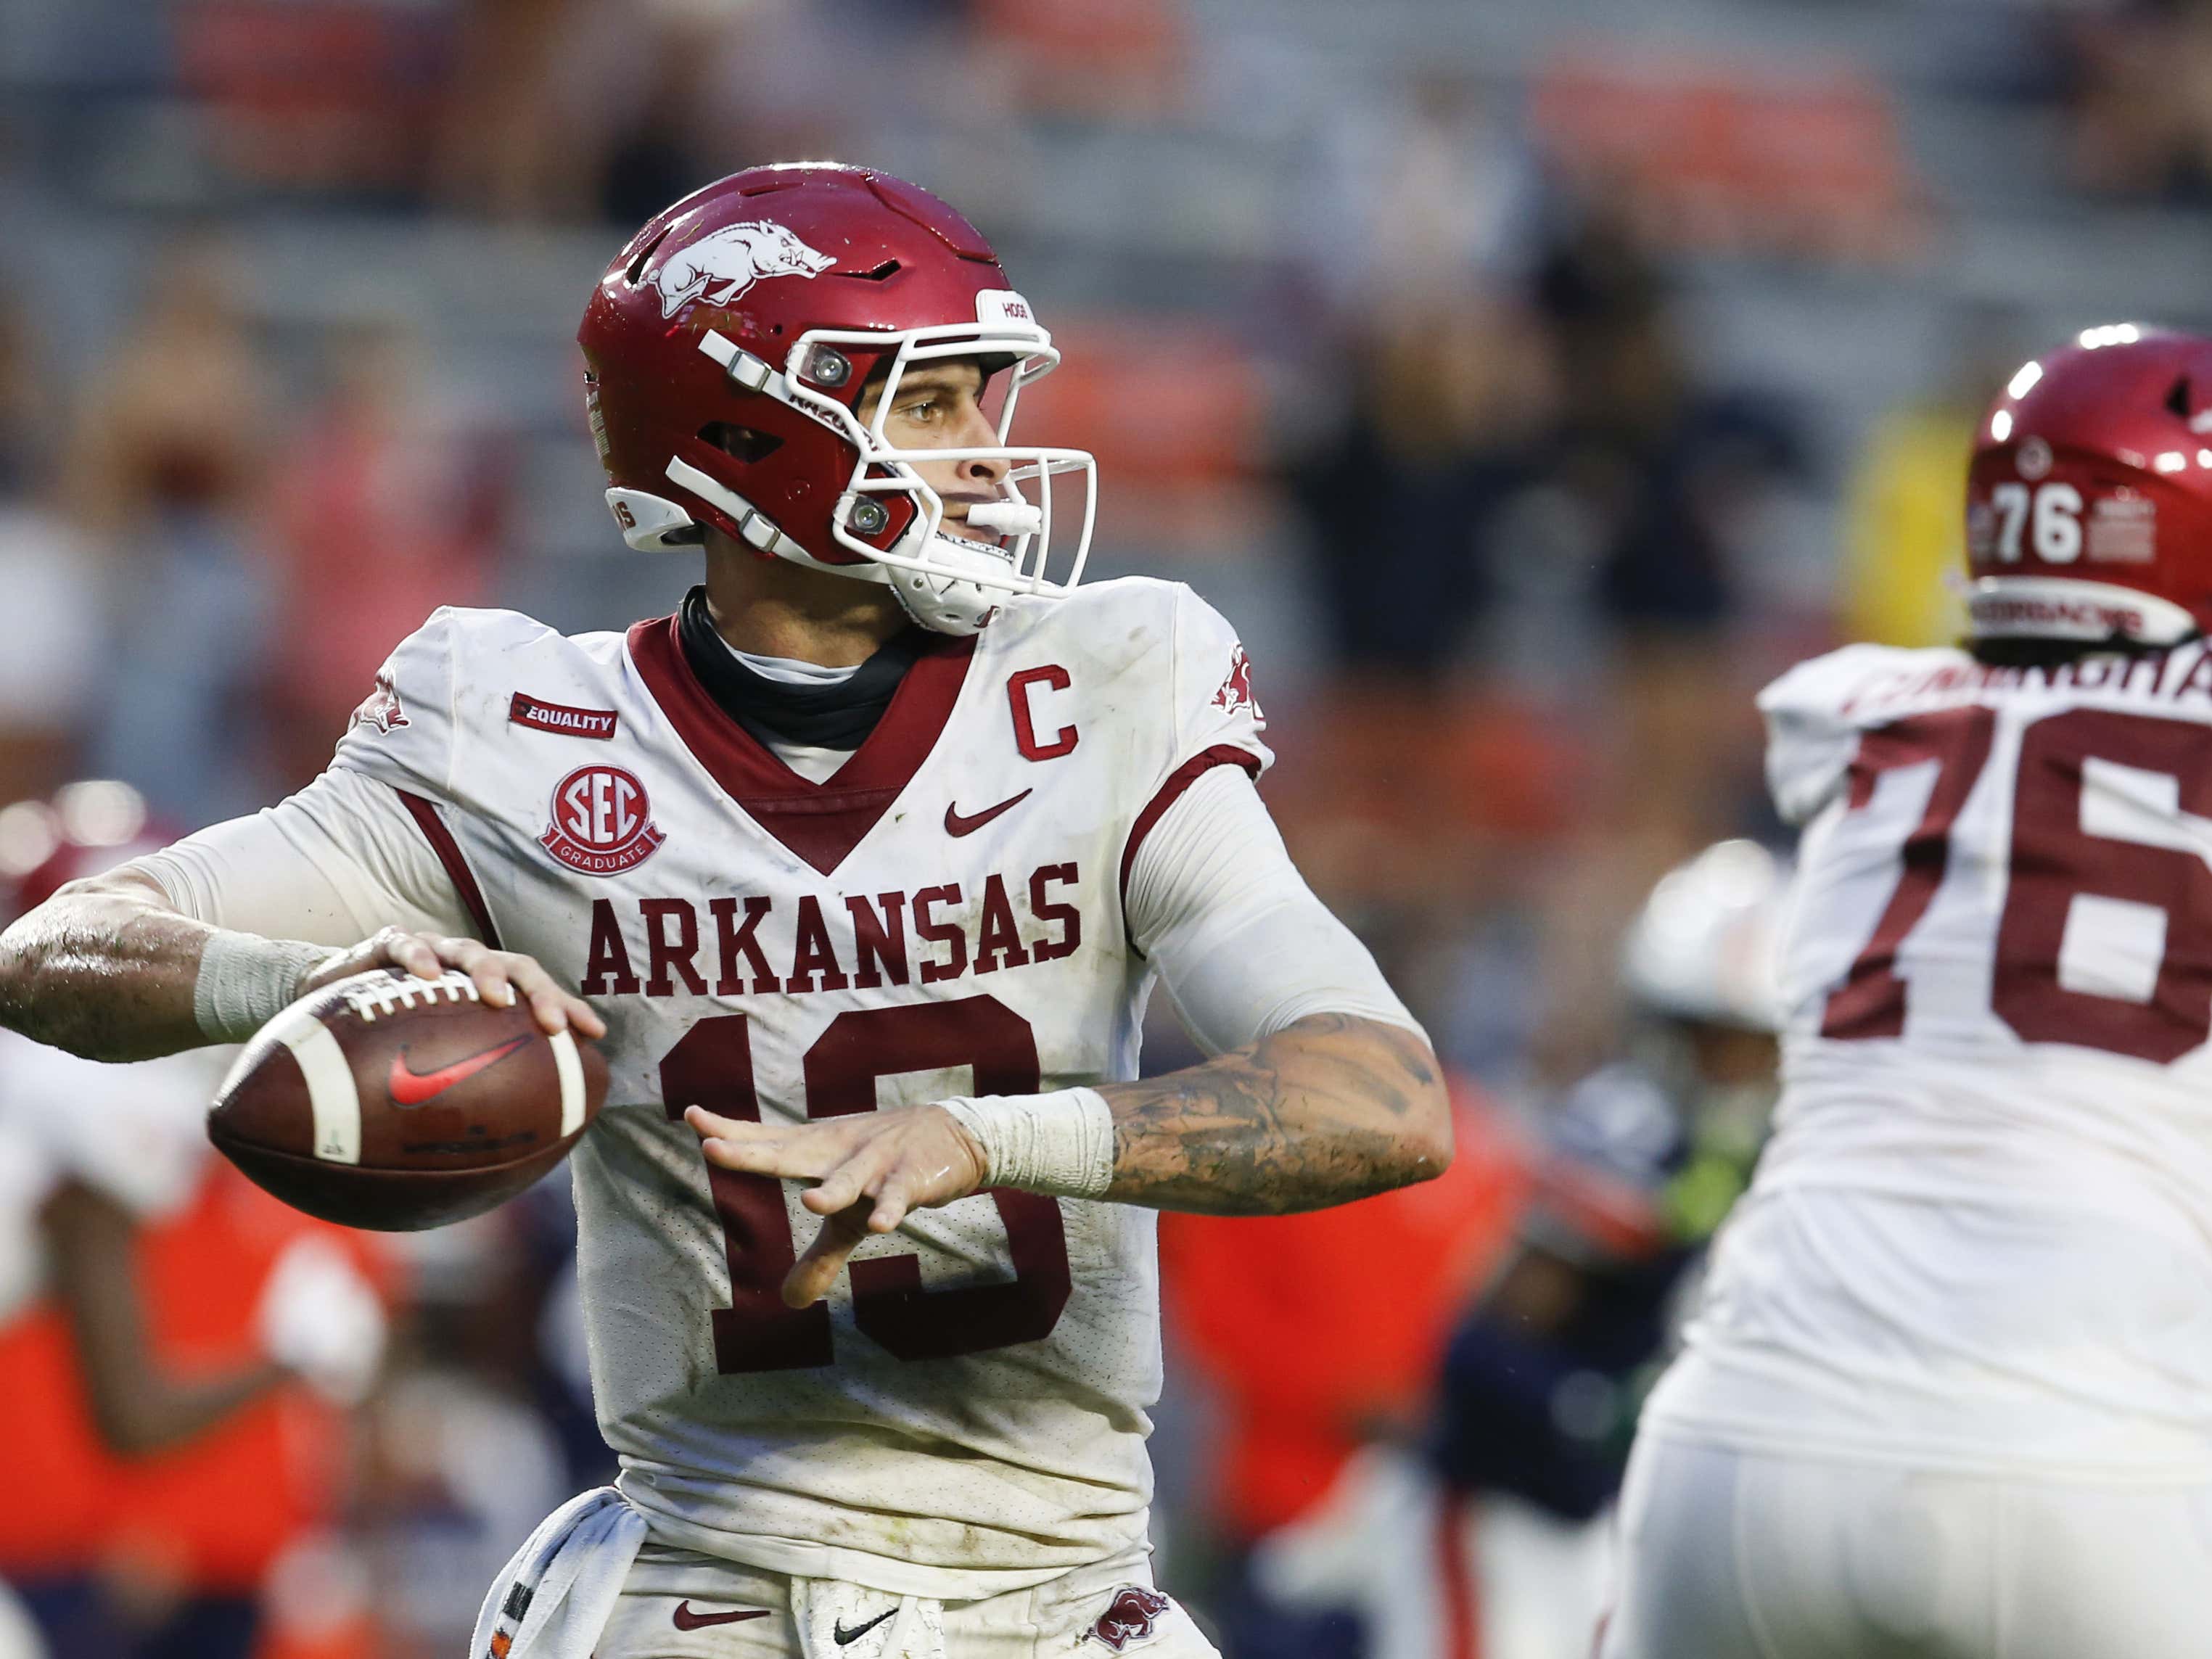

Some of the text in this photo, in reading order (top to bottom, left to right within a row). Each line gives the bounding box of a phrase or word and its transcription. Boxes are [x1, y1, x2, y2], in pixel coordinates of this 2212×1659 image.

[1992, 482, 2084, 564] 76
[526, 705, 613, 731] EQUALITY
[1007, 664, 1080, 762] C
[564, 773, 638, 844] SEC
[560, 843, 646, 870] GRADUATE
[1820, 704, 2212, 1066] 76
[580, 862, 1082, 997] ARKANSAS
[659, 993, 1072, 1375] 13
